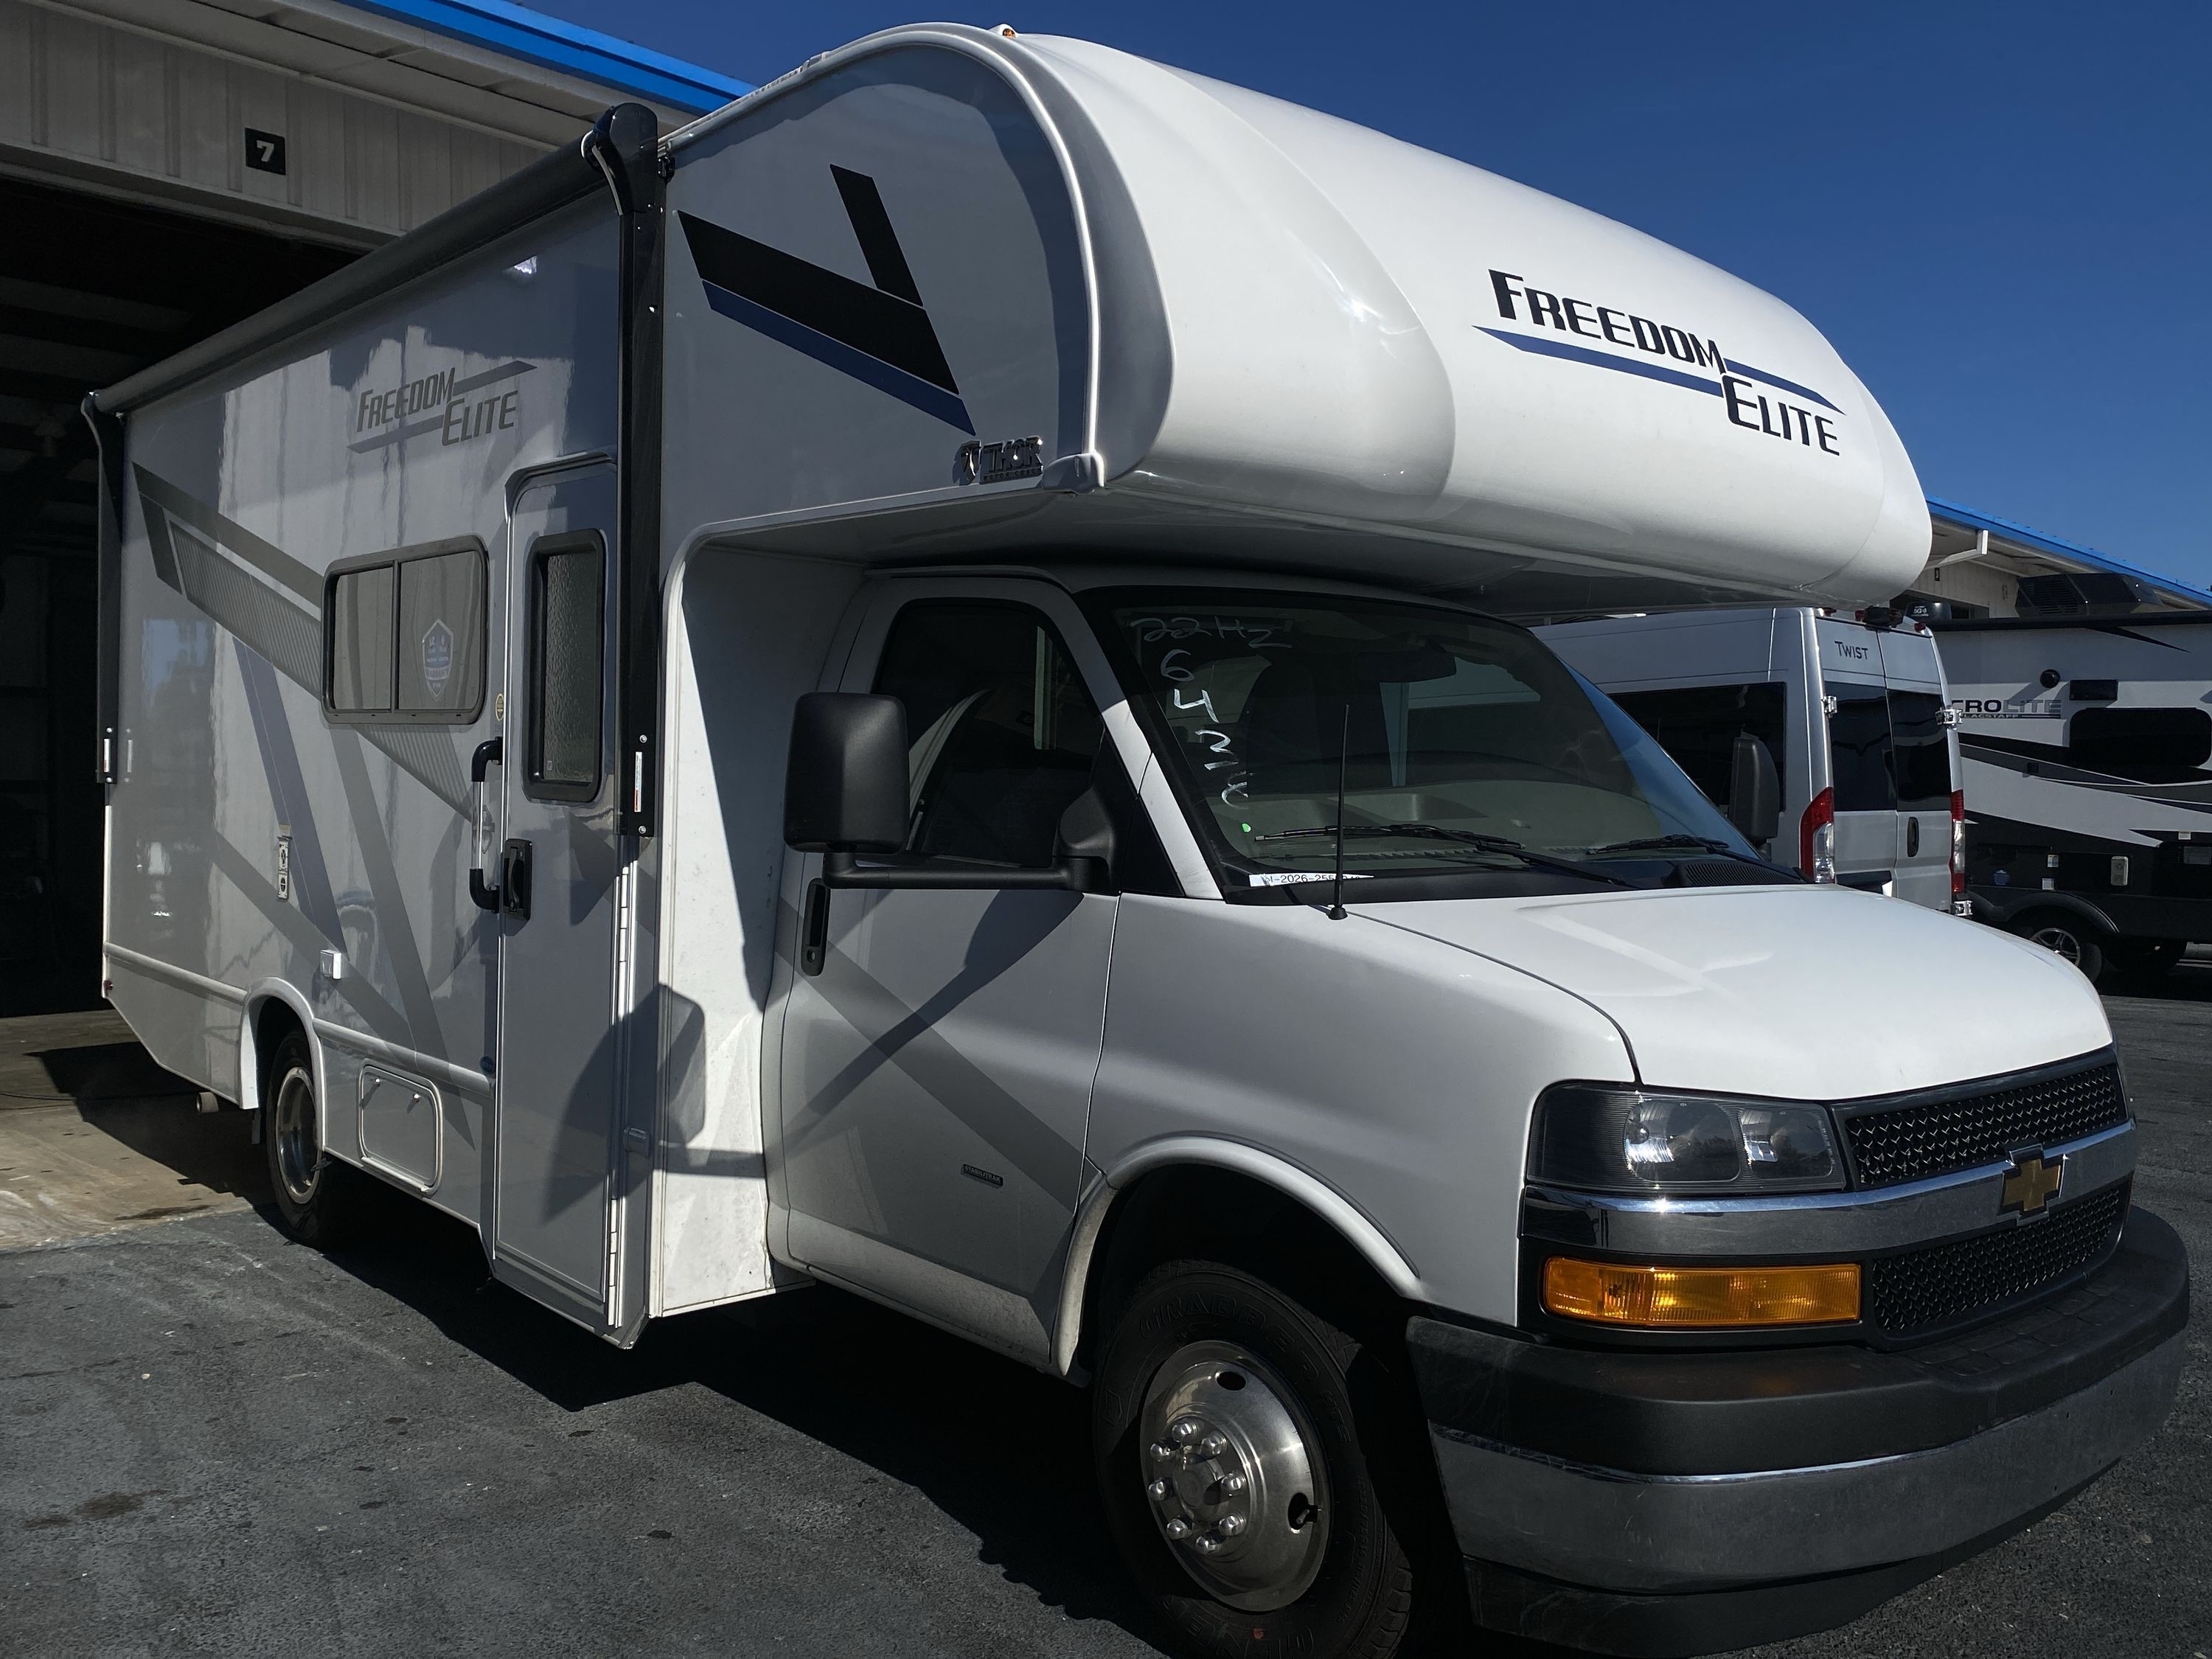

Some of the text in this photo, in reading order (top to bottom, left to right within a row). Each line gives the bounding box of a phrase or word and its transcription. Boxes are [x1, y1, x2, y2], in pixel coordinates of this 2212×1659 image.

[256, 139, 275, 162] 7
[1488, 268, 1726, 375] FREEDOM
[356, 367, 456, 433] FREEDOM
[442, 389, 518, 446] ELITE
[1722, 374, 1840, 456] ELITE
[981, 434, 1043, 473] THOR
[1834, 641, 1868, 660] TWIST
